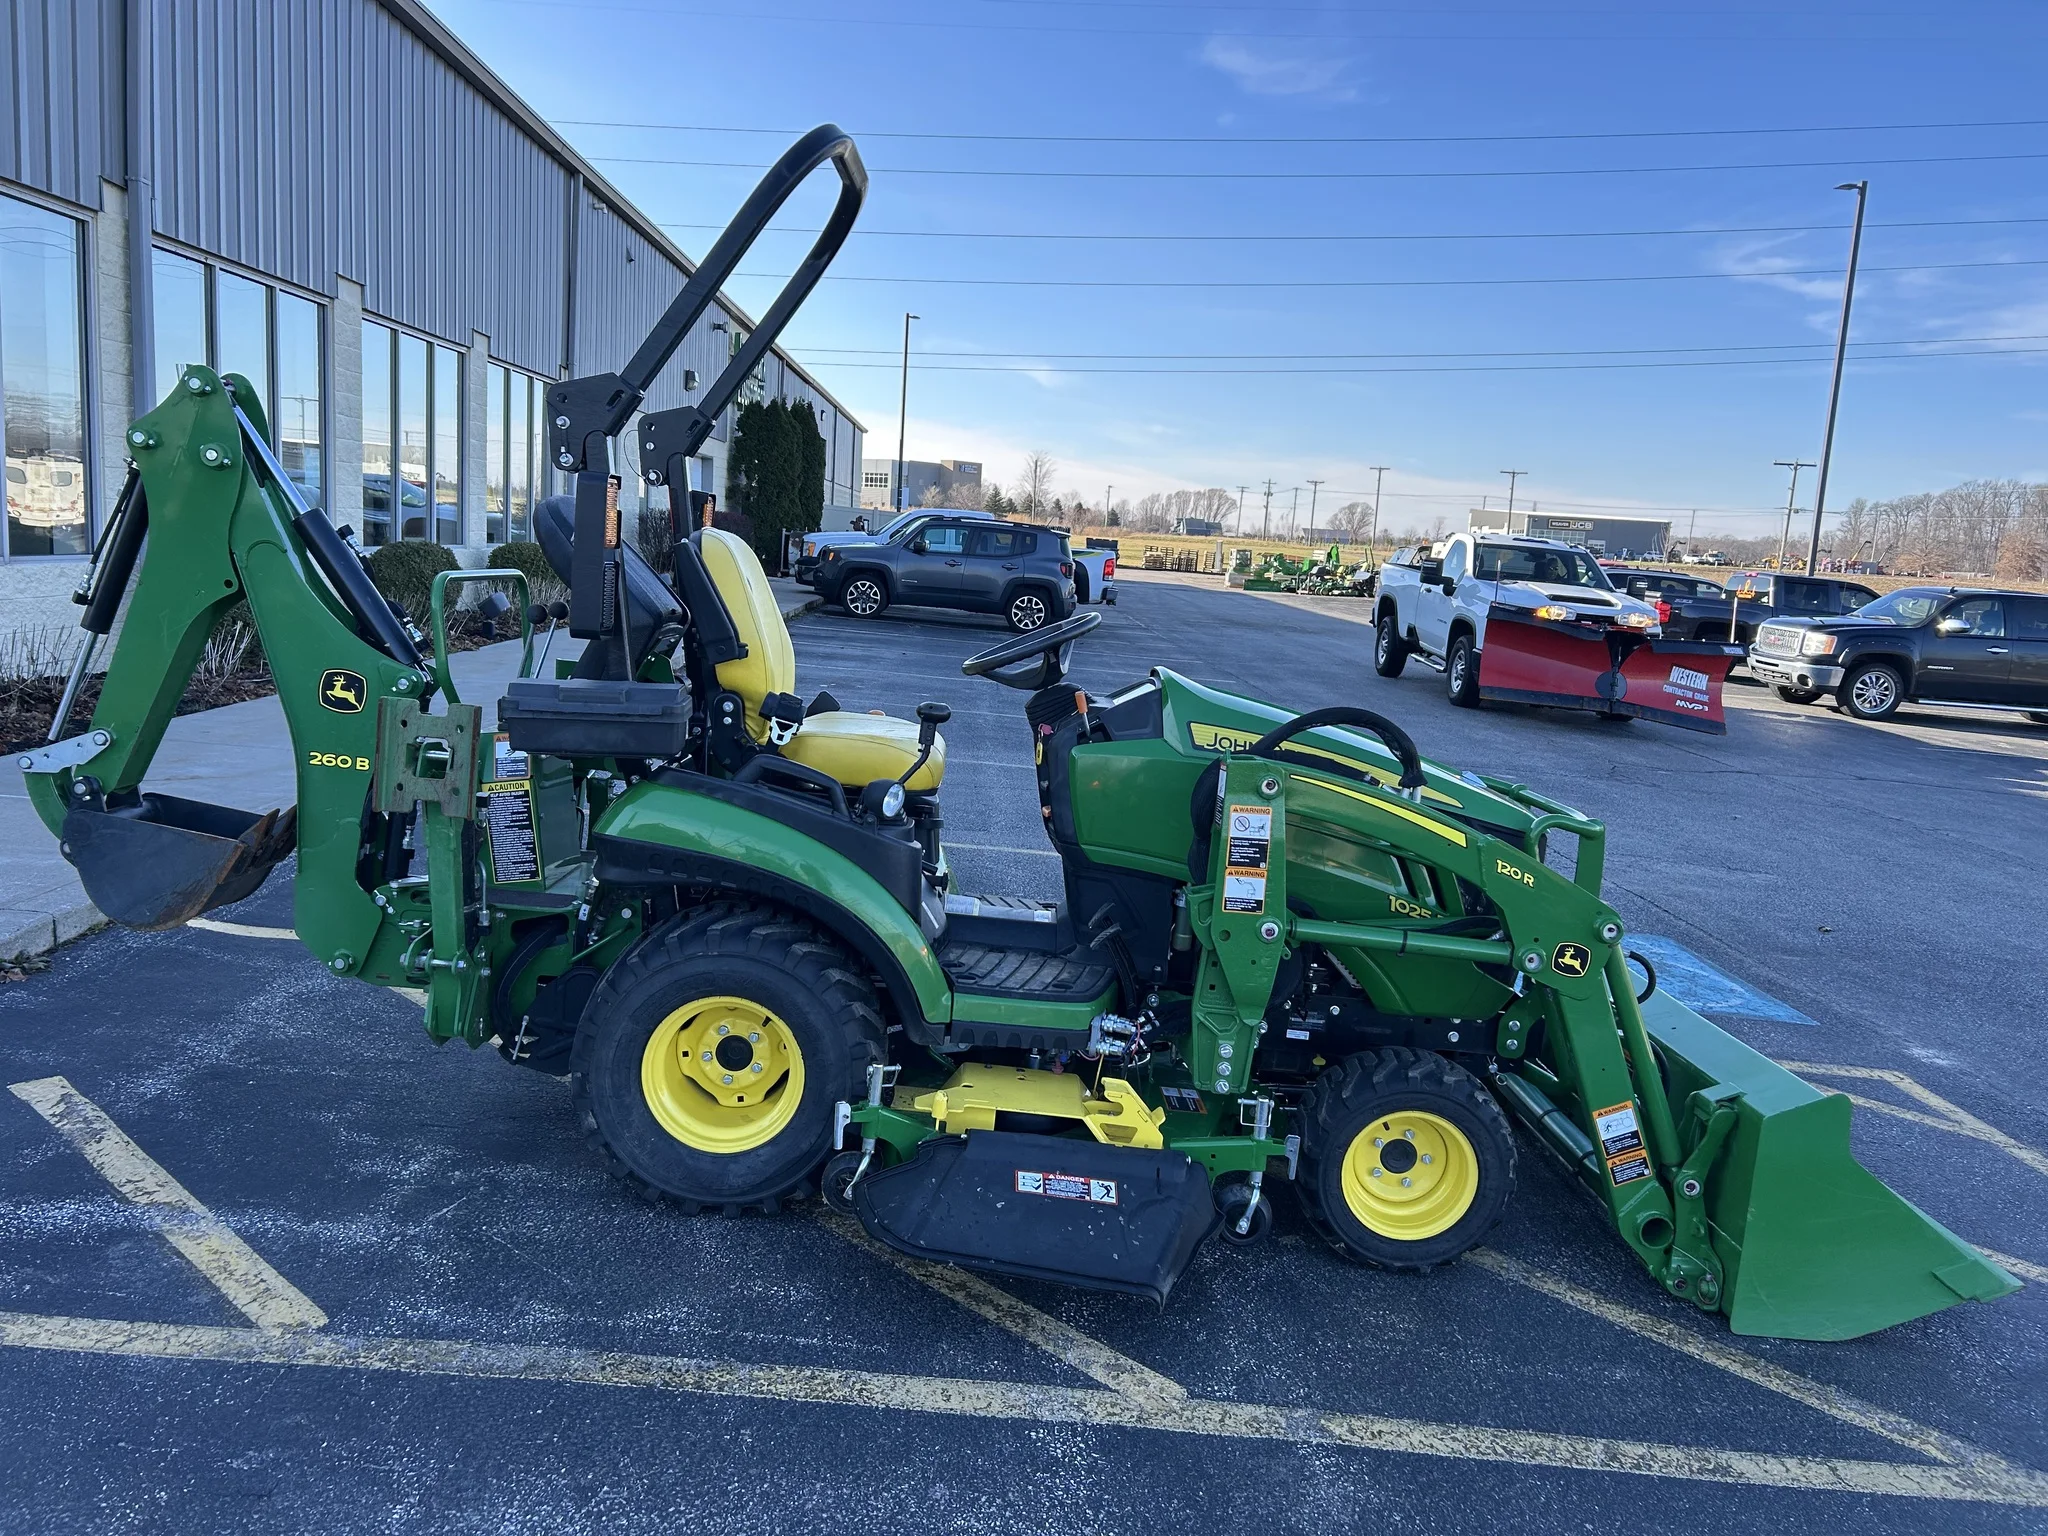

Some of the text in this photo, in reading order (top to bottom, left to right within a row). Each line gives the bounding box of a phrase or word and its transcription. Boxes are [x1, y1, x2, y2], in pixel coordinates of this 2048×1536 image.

[1571, 521, 1592, 529] JCB
[1669, 665, 1709, 691] WESTERN
[309, 751, 370, 771] 260 B
[494, 782, 525, 791] CAUTION
[1239, 807, 1270, 815] WARNING
[1234, 870, 1265, 878] WARNING
[1496, 859, 1535, 888] 120 R
[1603, 1103, 1629, 1115] WARNING
[1617, 1152, 1643, 1163] WARNING
[1055, 1174, 1085, 1183] DANGER
